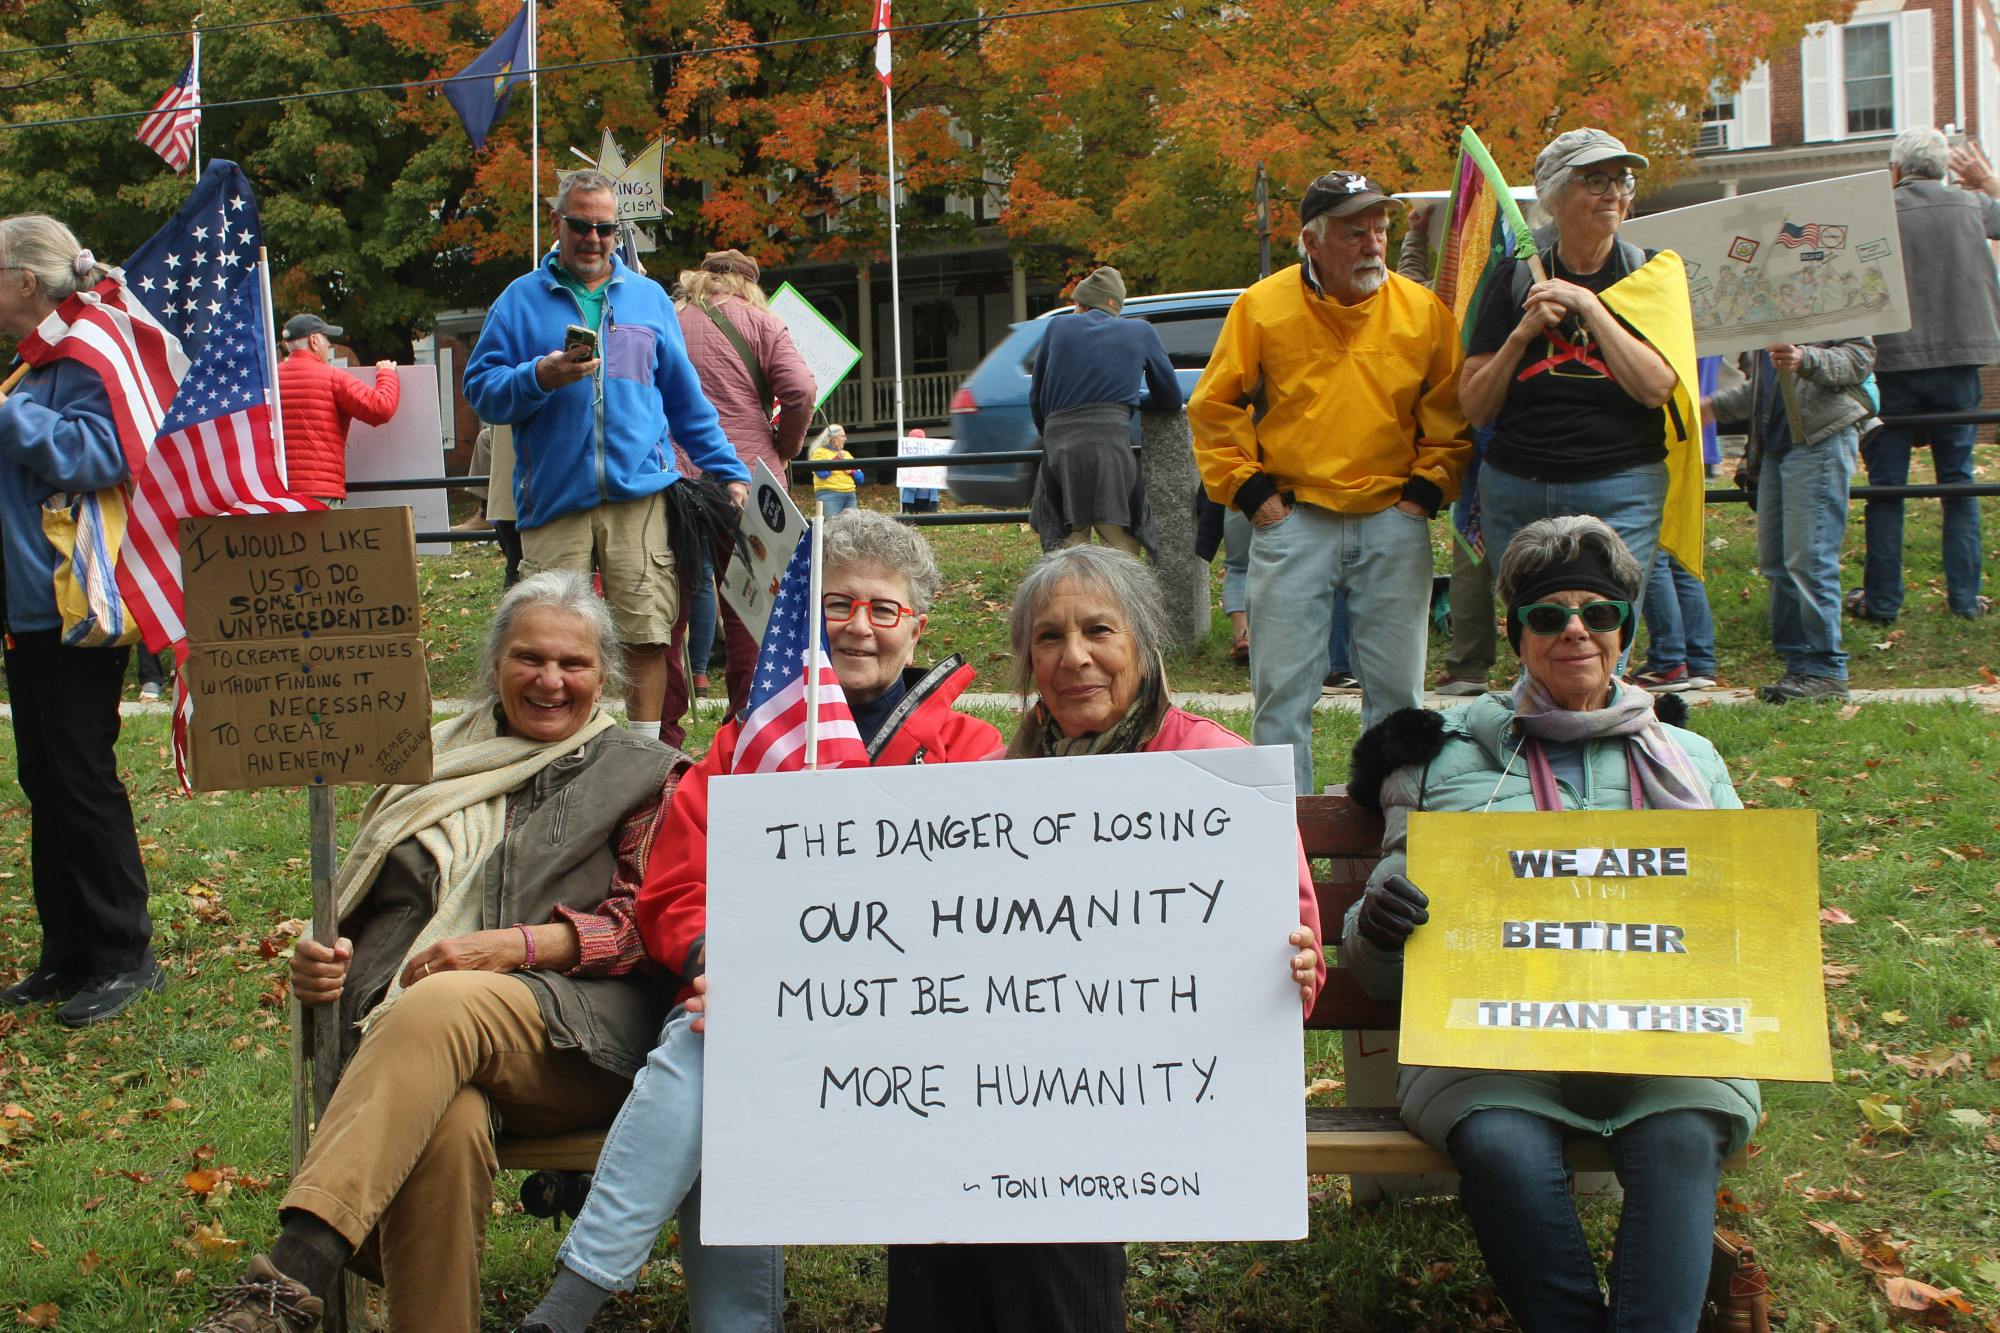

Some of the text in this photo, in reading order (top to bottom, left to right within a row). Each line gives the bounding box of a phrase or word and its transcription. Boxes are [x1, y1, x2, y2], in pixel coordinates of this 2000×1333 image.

[612, 181, 653, 195] INGS
[224, 532, 306, 559] WOULD
[321, 528, 383, 553] LIKE
[250, 564, 358, 595] US TO DO
[230, 586, 364, 615] SOMETHING
[219, 604, 412, 639] UNPRECEDENTED:
[206, 643, 412, 668] TO CREATE OURSELVES
[201, 672, 374, 695] WITHOUT FINDING IT
[270, 691, 406, 717] NECESSARY
[211, 722, 339, 745] TO CREATE
[248, 753, 277, 772] AN
[384, 731, 427, 775] BALDWIN
[766, 808, 1232, 861] THE DANGER OF LOSING
[1508, 848, 1688, 878] WE ARE
[799, 879, 1224, 954] OUR HUMANITY
[1503, 922, 1686, 953] BETTER
[777, 974, 1198, 1021] MUST BE MET WITH
[1478, 1002, 1743, 1032] THAN THIS!
[820, 1056, 1218, 1118] MORE HUMANITY.
[991, 1175, 1047, 1199] TONI
[1060, 1172, 1201, 1200] MORRISON
